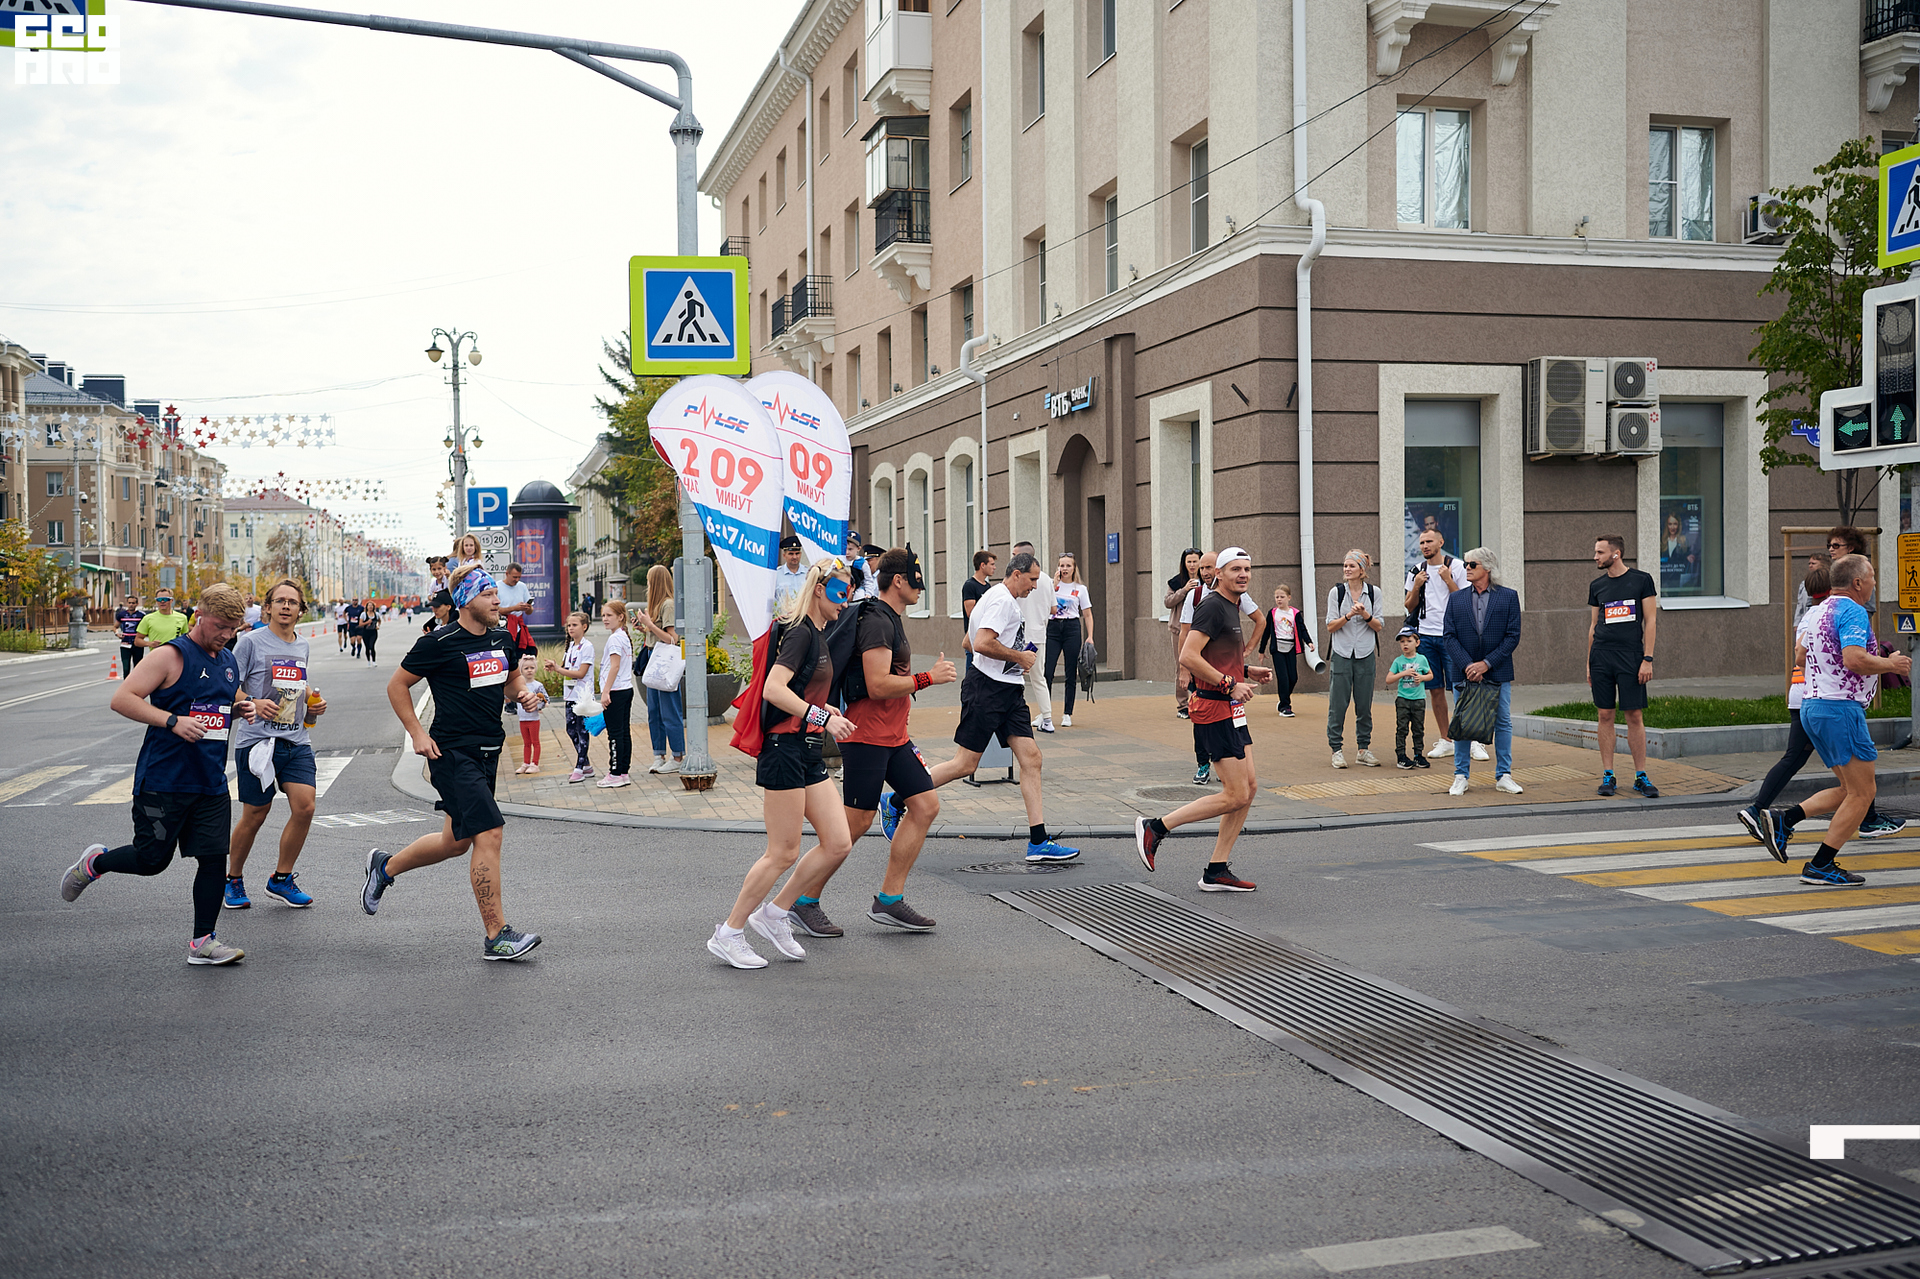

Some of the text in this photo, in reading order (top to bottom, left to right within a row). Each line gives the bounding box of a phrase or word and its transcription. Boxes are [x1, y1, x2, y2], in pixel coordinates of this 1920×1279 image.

[1050, 385, 1088, 419] ВТБ БАНК
[680, 437, 764, 497] 2 09
[790, 442, 833, 490] 09
[477, 492, 500, 523] P
[1687, 503, 1699, 511] ВТБ
[493, 535, 504, 543] 20
[517, 541, 542, 563] 19
[1909, 595, 1917, 603] 90
[1607, 607, 1629, 617] 5402
[275, 668, 298, 679] 2115
[472, 660, 499, 676] 2126
